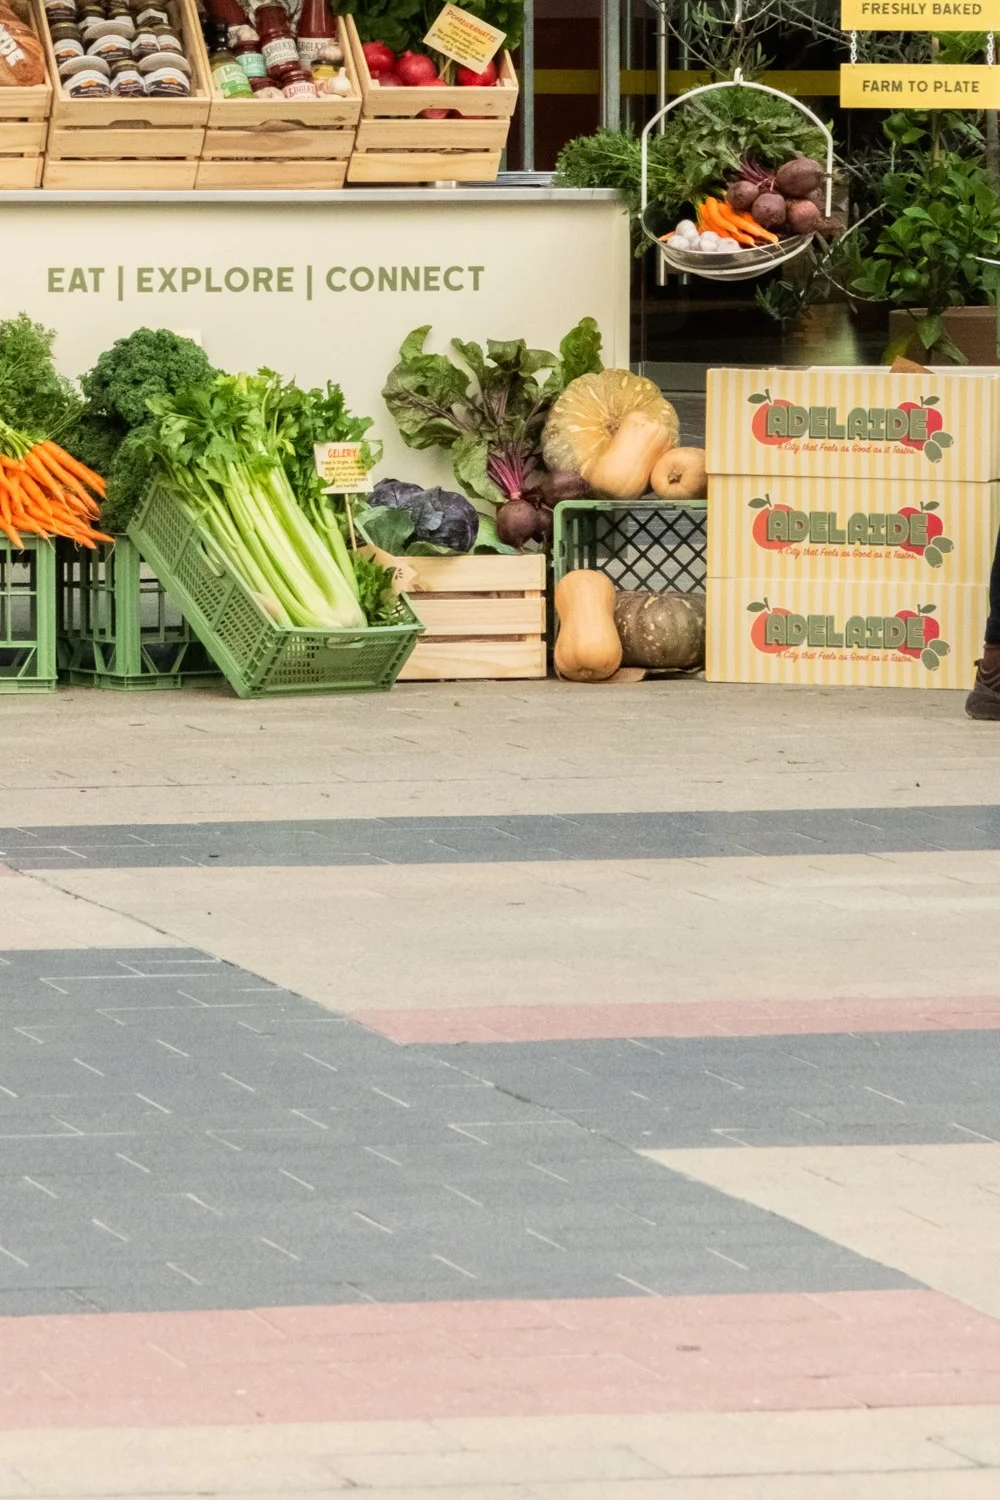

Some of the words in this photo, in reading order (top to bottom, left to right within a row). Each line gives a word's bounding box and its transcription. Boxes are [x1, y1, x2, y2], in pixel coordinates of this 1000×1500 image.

[861, 2, 928, 16] FRESHLY
[932, 2, 982, 16] BAKED
[446, 10, 497, 43] POMEGRANATES
[862, 80, 902, 94] FARM
[908, 80, 928, 93] TO
[933, 80, 980, 93] PLATE
[47, 267, 106, 293] EAT
[137, 266, 294, 293] EXPLORE
[325, 266, 485, 292] CONNECT
[766, 405, 928, 441] ADELAIDE
[328, 448, 357, 458] CELERY
[785, 443, 799, 454] City
[766, 510, 928, 545] ADELAIDE
[785, 548, 800, 559] City
[765, 613, 925, 649] ADELAIDE
[783, 651, 798, 662] City
